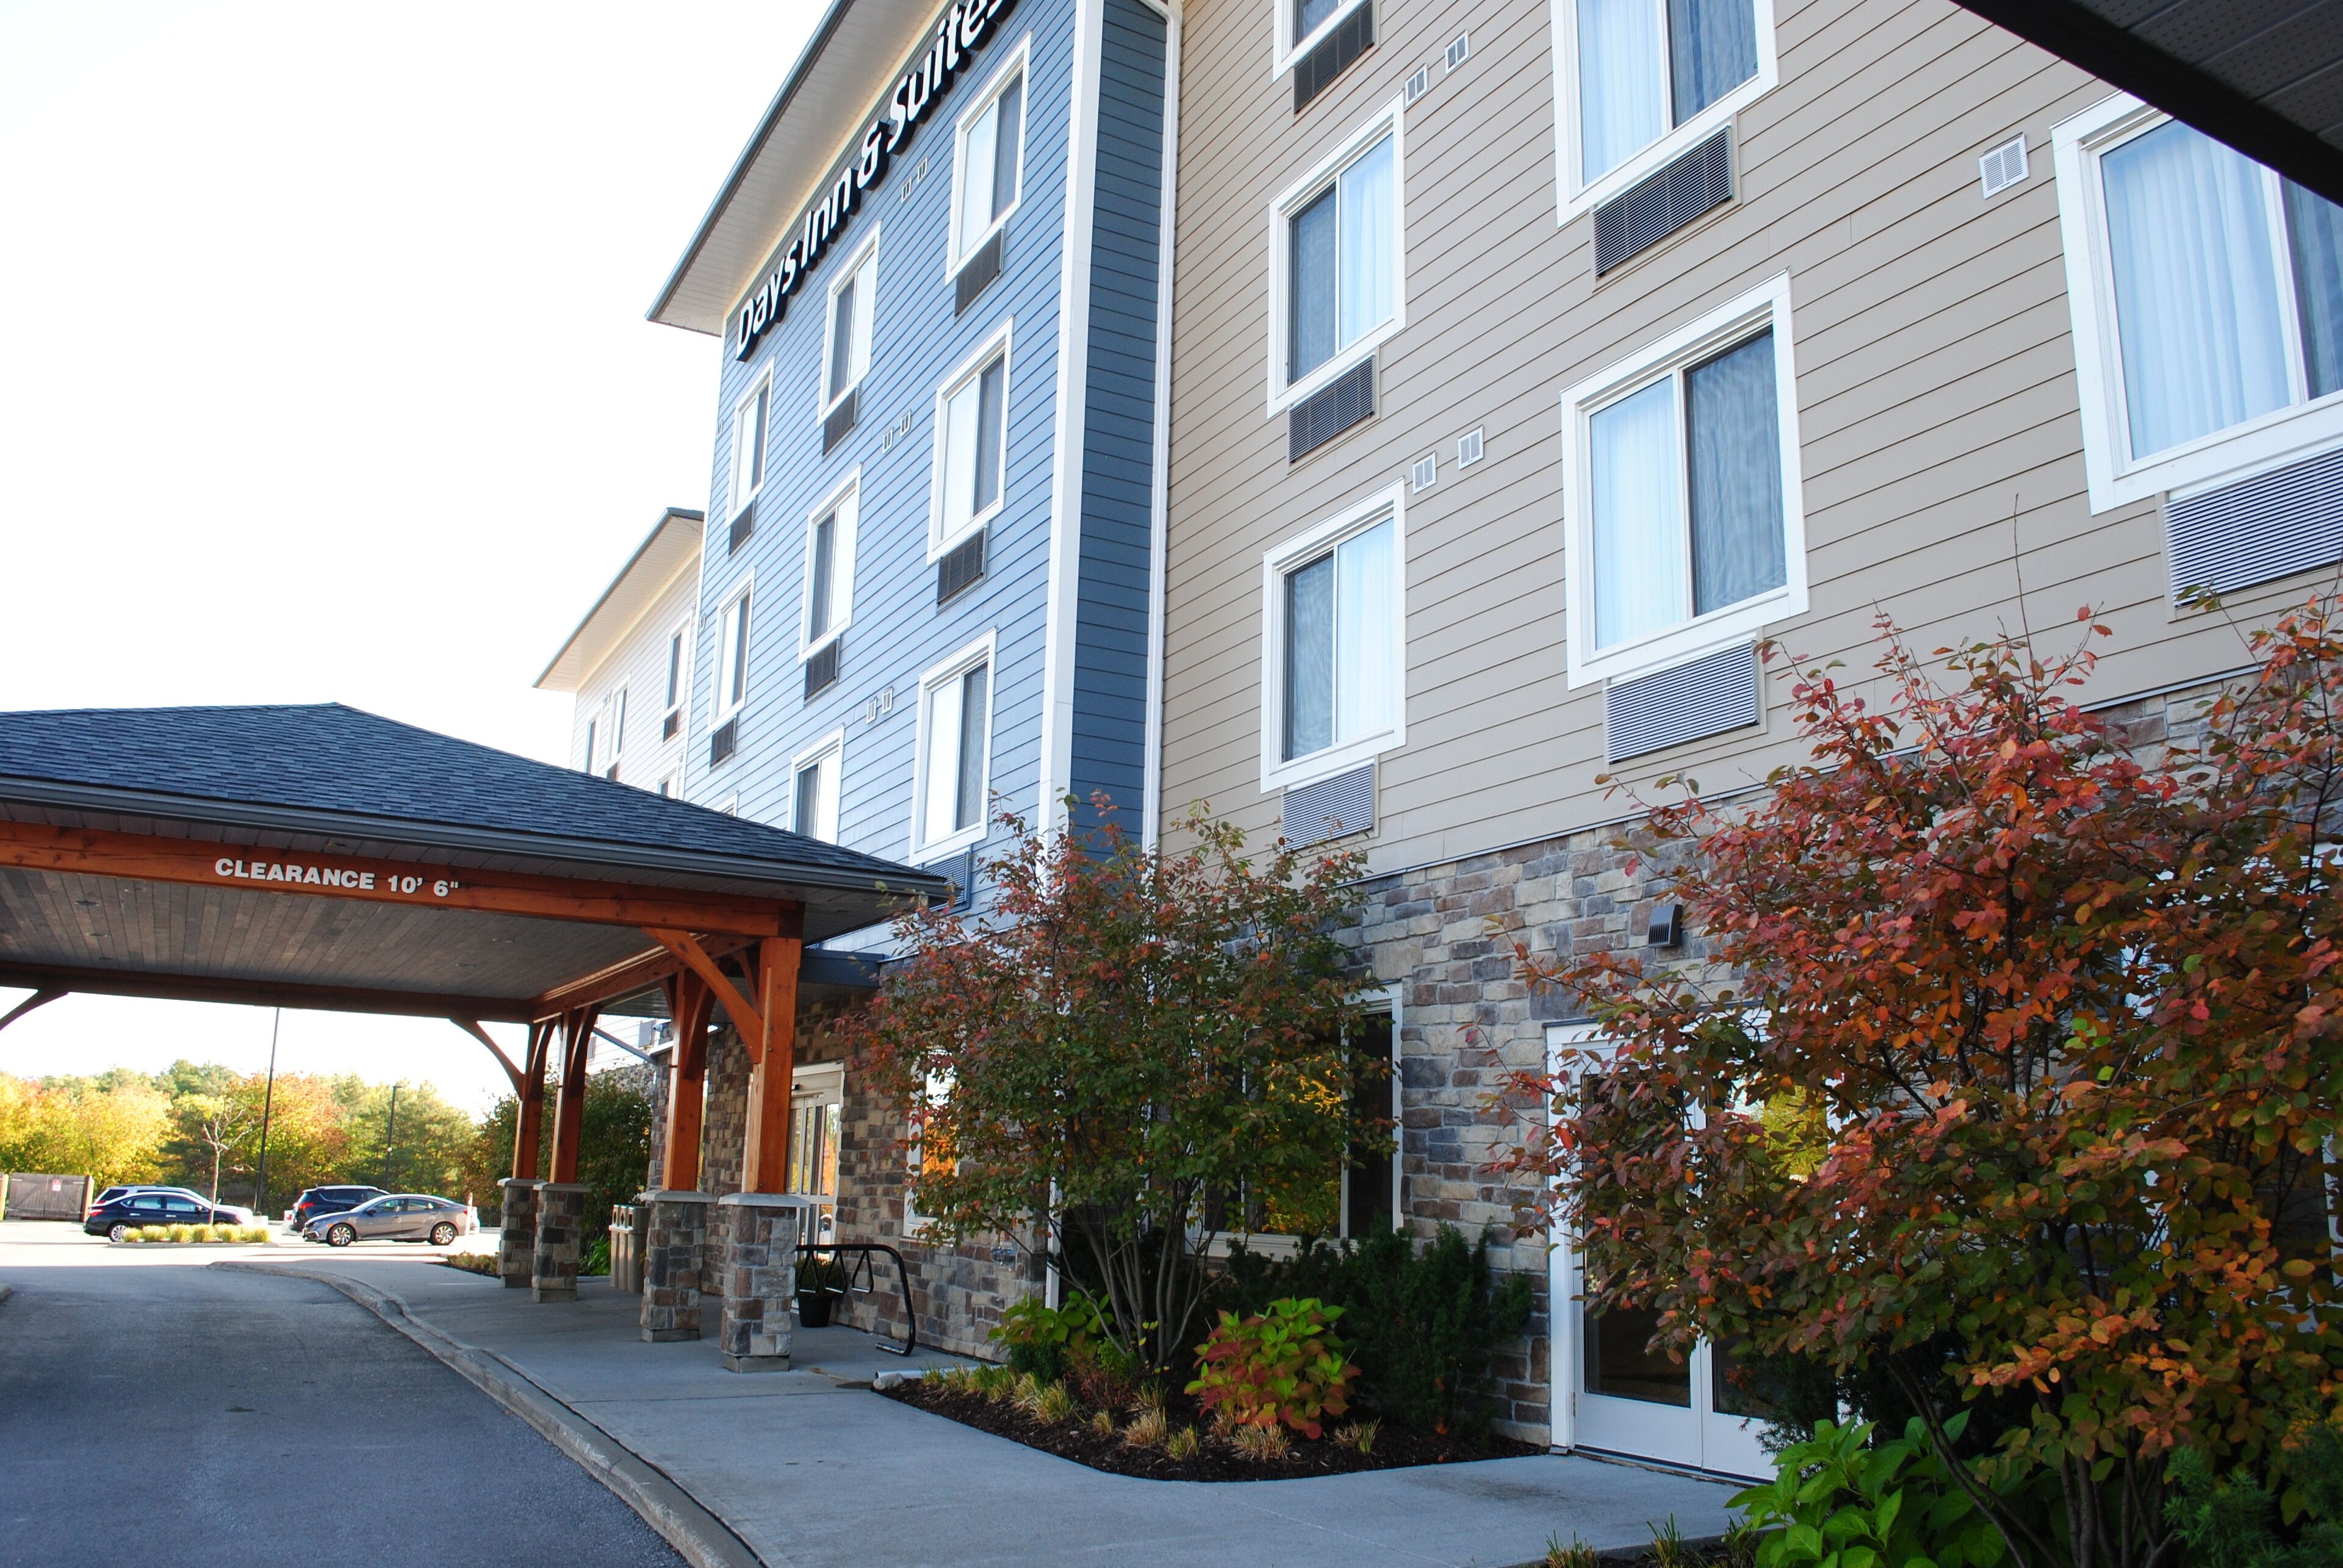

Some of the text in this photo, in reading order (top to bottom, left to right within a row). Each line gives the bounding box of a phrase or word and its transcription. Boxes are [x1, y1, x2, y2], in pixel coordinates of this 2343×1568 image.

[736, 0, 1004, 361] Days Inn & Suite
[215, 858, 459, 897] CLEARANCE 10' 6"
